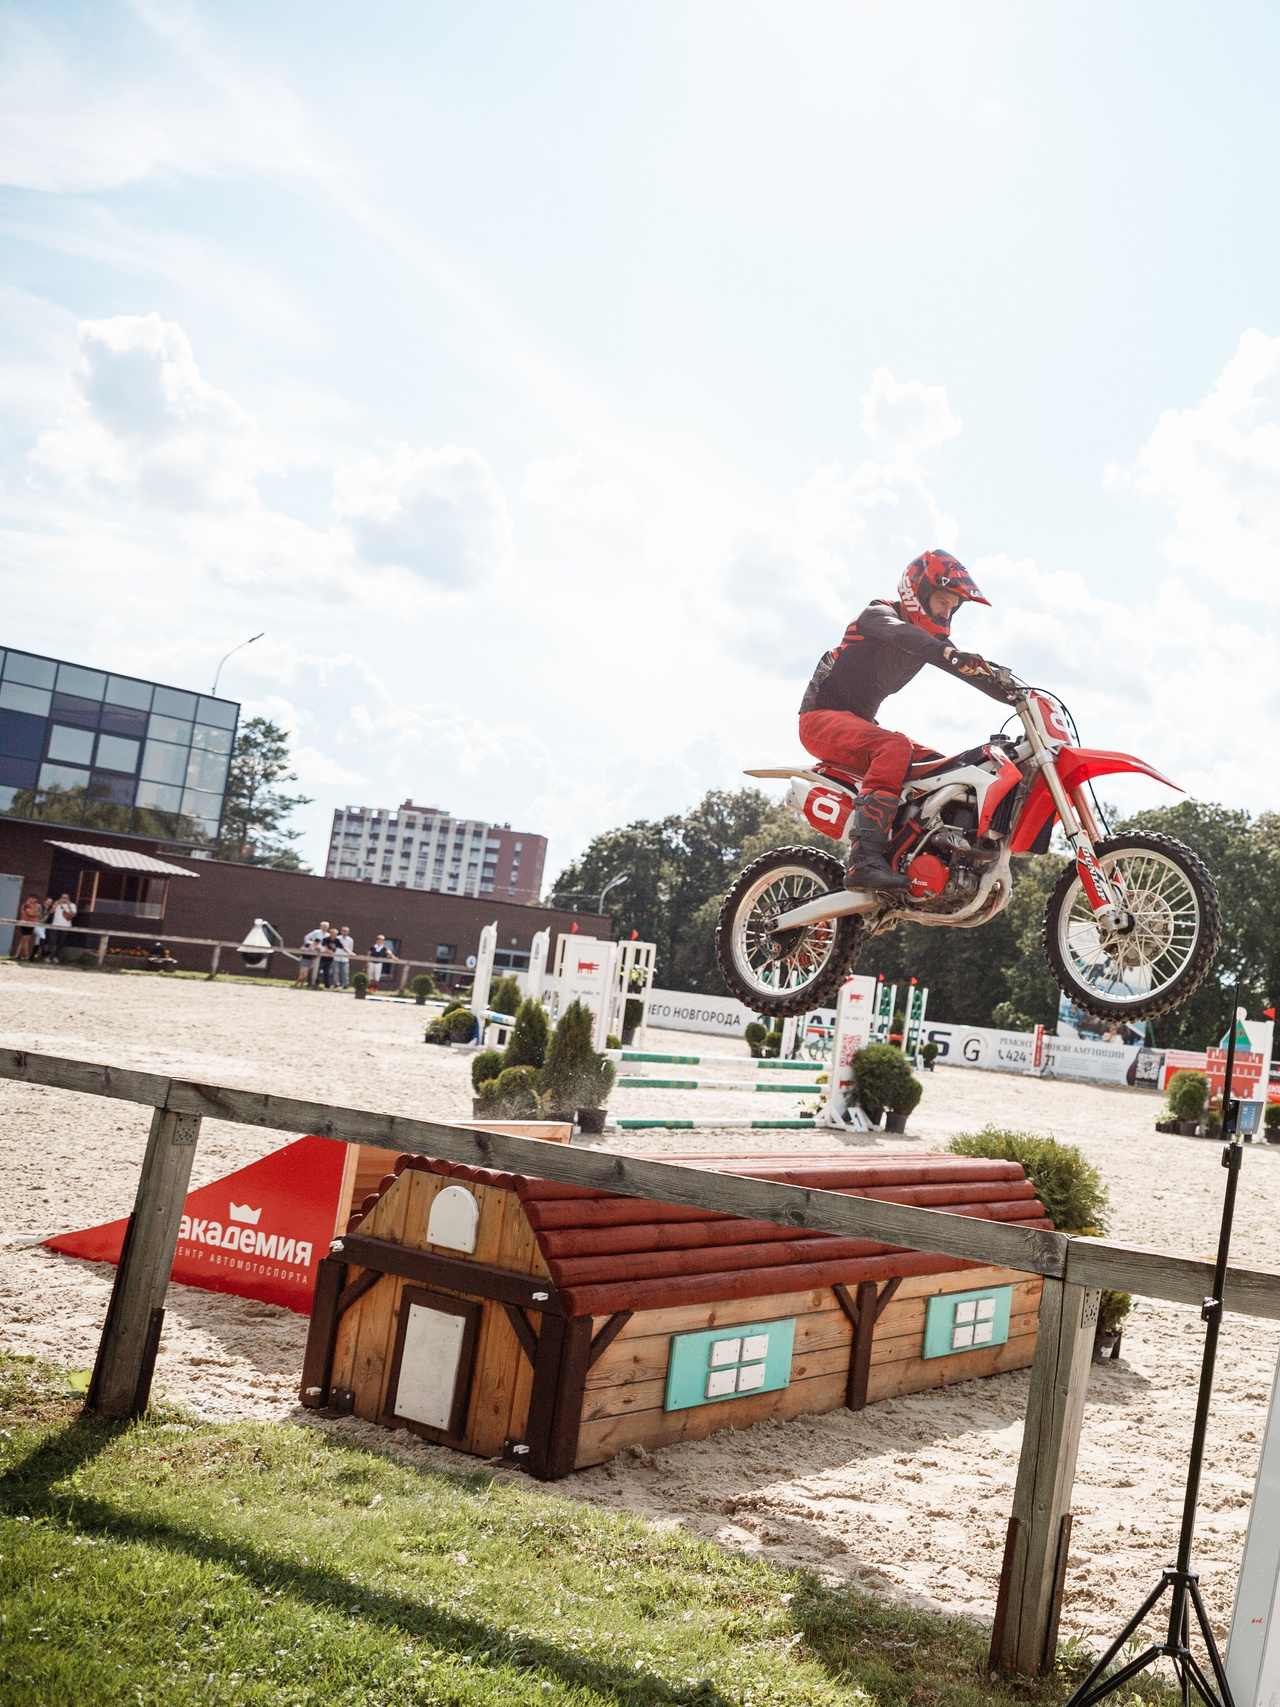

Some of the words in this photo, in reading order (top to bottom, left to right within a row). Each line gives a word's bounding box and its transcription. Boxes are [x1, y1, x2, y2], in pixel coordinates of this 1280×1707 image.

[1081, 846, 1107, 901] DUNLOP
[673, 1007, 741, 1026] НОВГОРОДА
[178, 1214, 313, 1267] академия
[209, 1253, 308, 1285] АВТОМОТОСПОРТА
